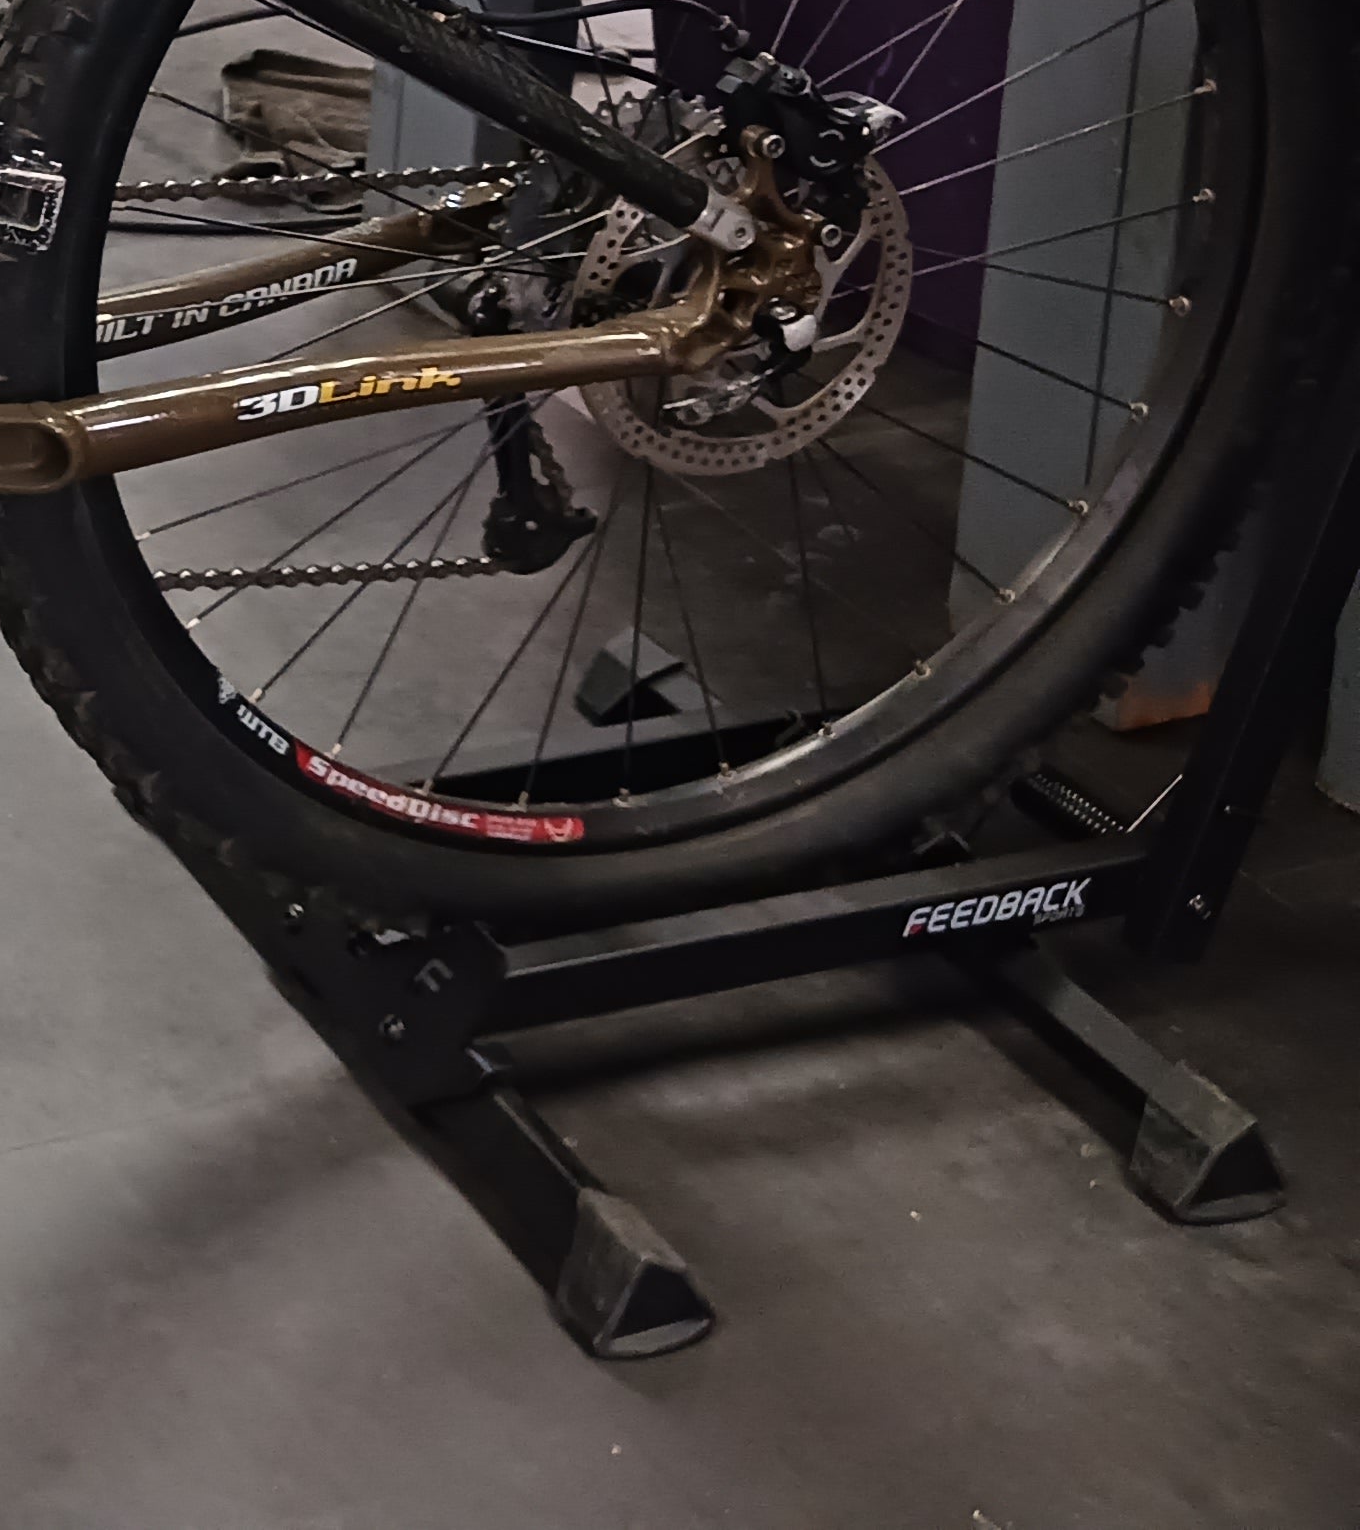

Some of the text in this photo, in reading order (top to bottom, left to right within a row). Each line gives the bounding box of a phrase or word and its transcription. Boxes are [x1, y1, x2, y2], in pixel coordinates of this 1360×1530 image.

[95, 256, 358, 344] ILT IN CANADA
[236, 703, 292, 756] WTB
[902, 876, 1092, 938] FEEDBACK
